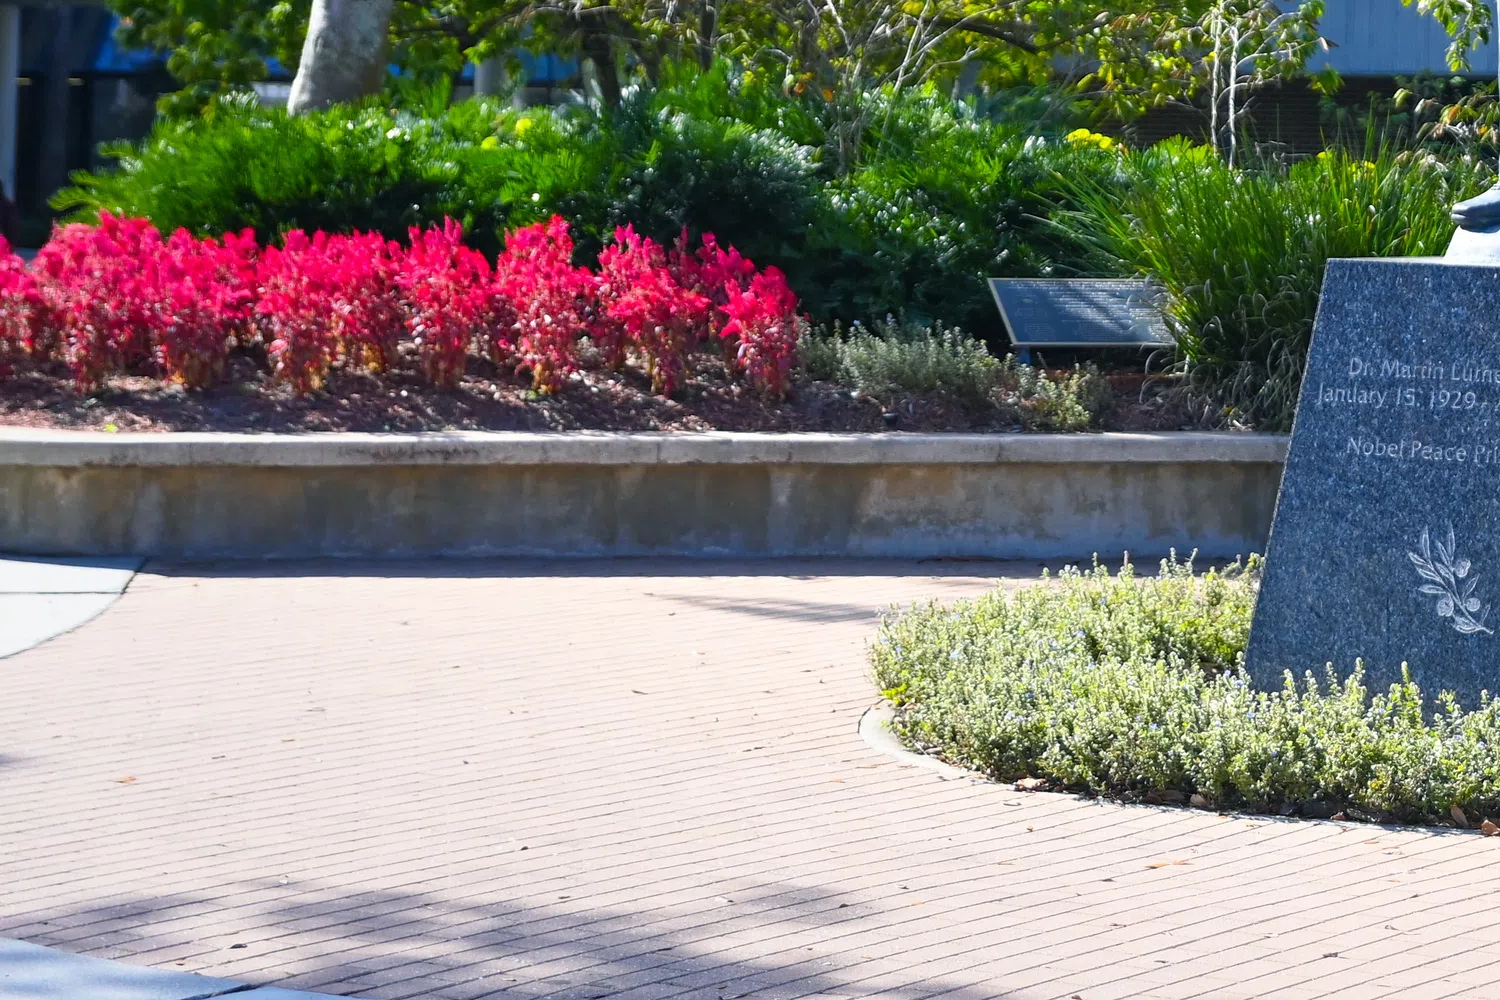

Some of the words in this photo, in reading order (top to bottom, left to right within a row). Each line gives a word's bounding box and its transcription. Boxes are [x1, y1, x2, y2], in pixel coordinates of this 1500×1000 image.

[1379, 359, 1444, 380] Martin
[1315, 382, 1388, 409] January
[1429, 387, 1476, 410] 1929
[1346, 436, 1405, 459] Nobel
[1410, 440, 1467, 462] Peace
